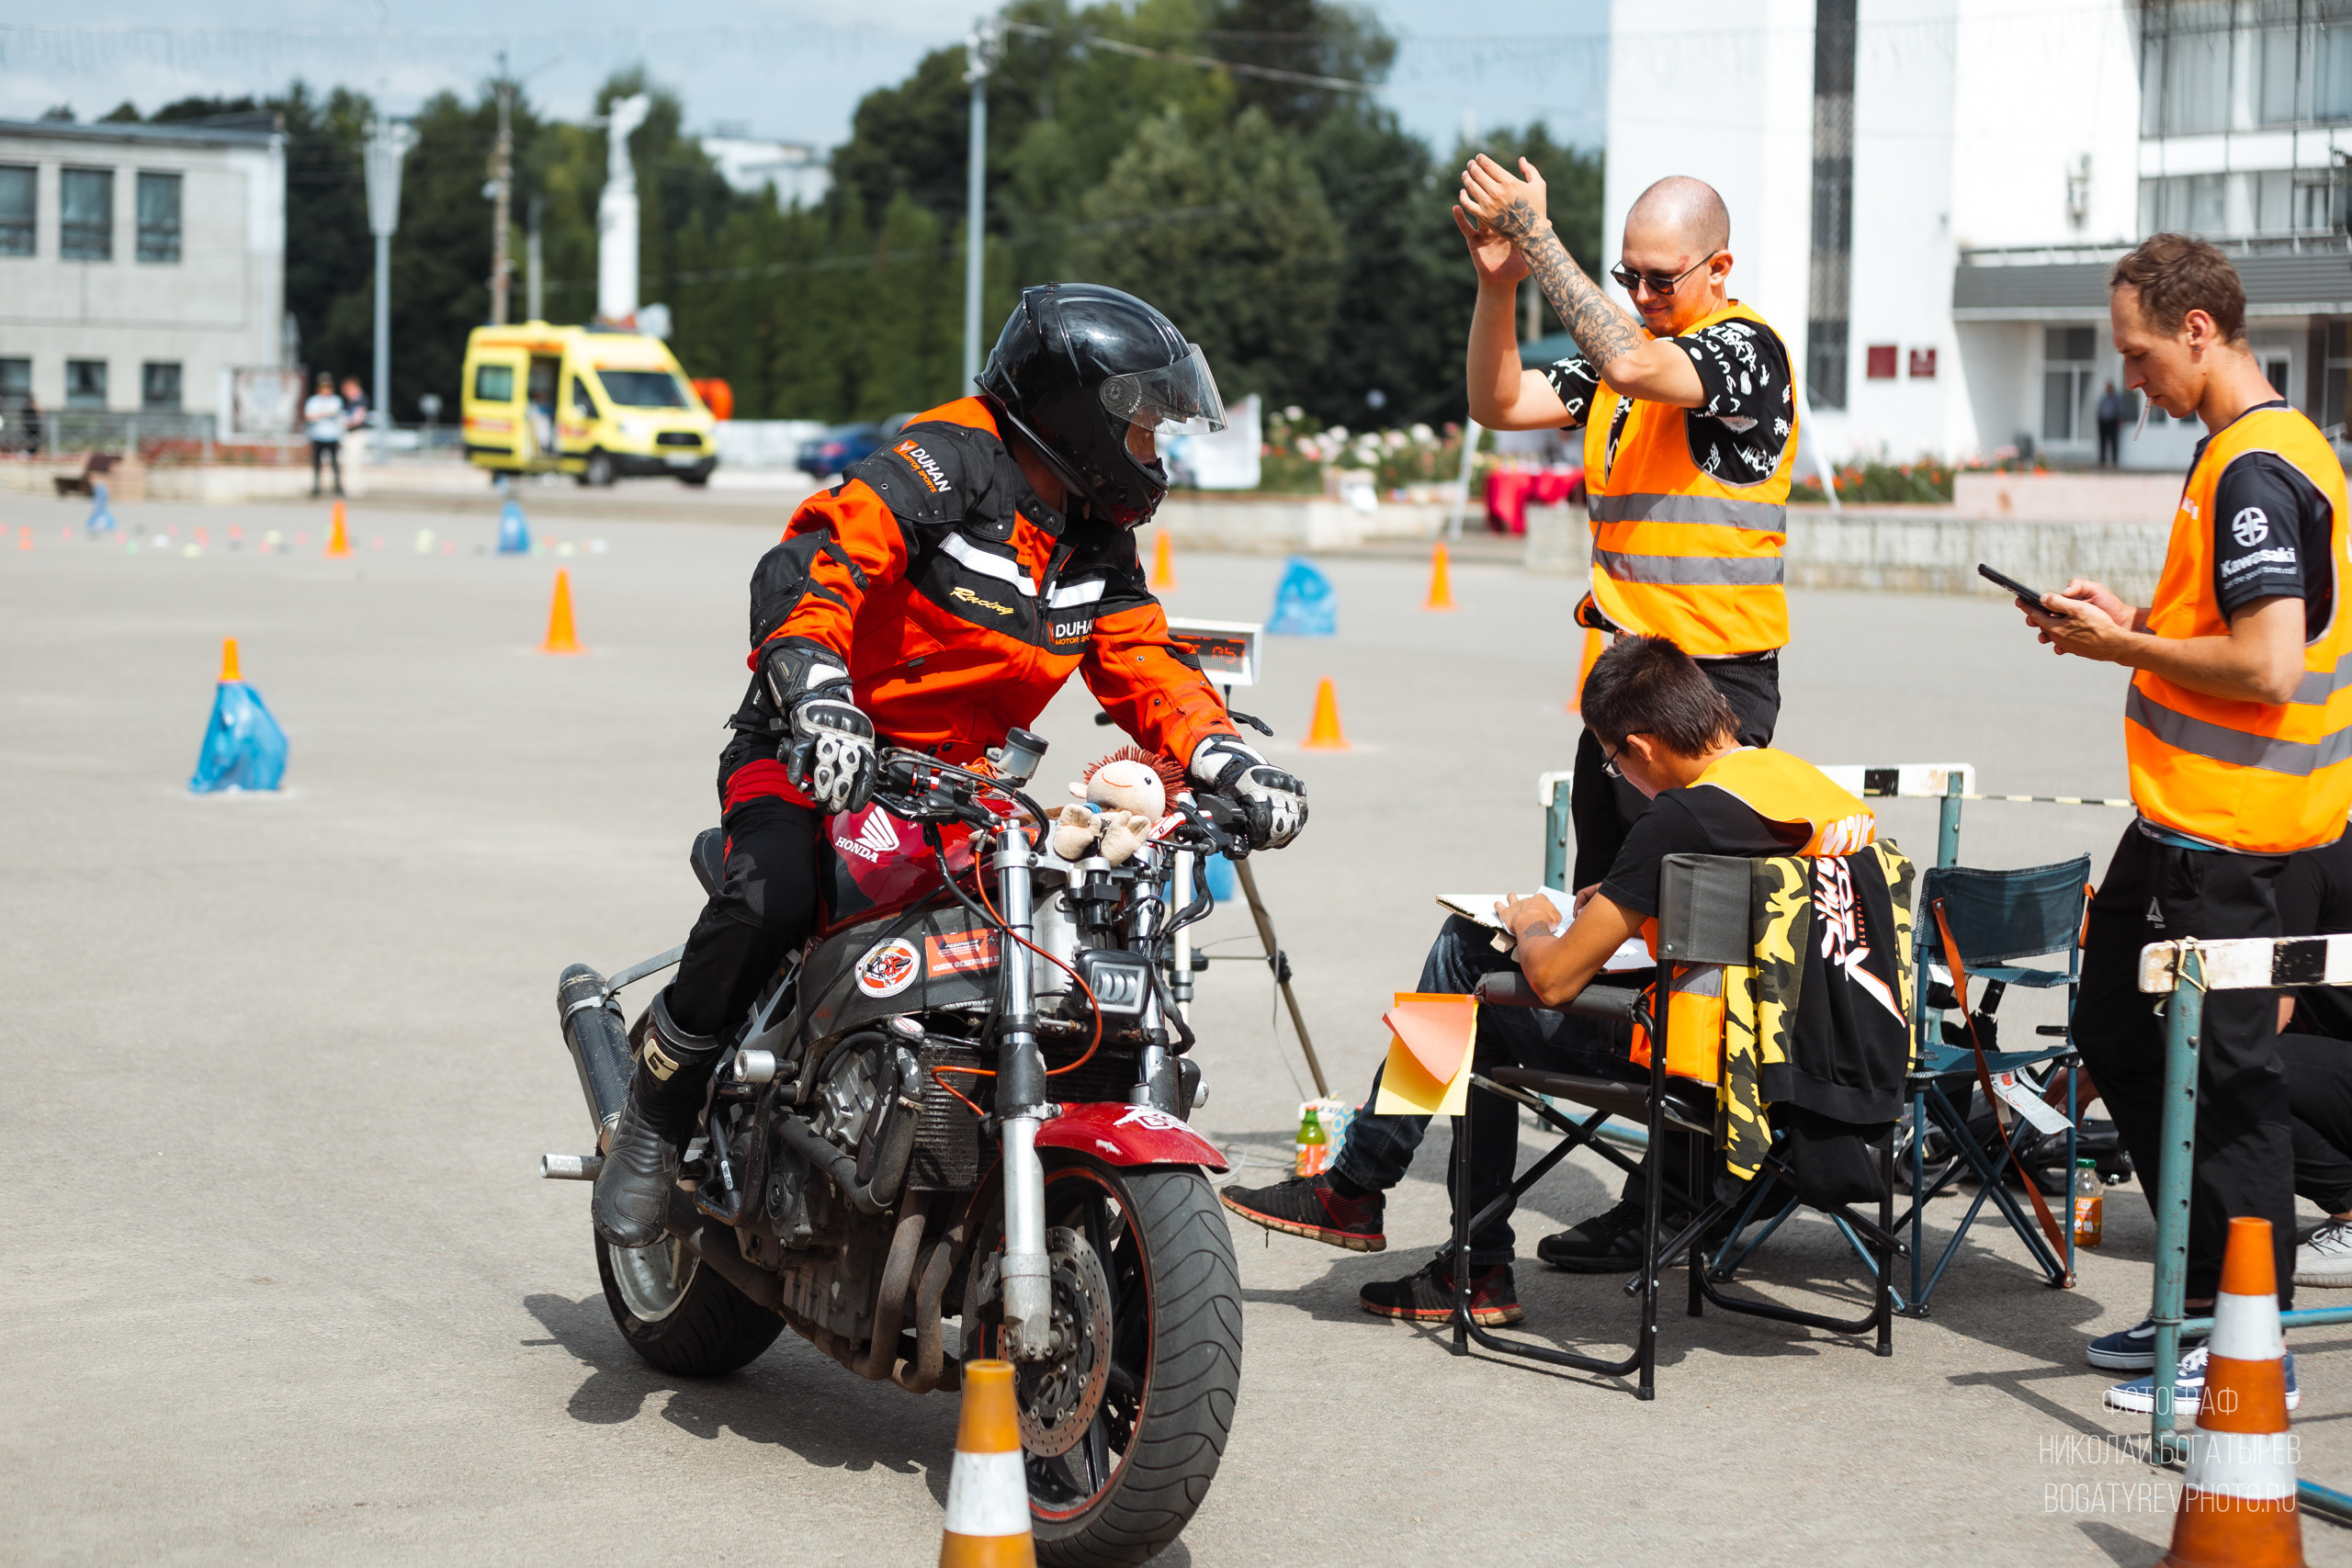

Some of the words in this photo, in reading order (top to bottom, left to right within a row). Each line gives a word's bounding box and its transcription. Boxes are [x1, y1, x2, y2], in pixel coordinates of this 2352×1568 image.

[910, 447, 952, 492] DUHAN
[918, 469, 938, 493] SPORTS
[2220, 547, 2296, 578] Kawasaki
[950, 586, 1014, 615] Racing
[1056, 616, 1095, 637] DUHA
[1056, 636, 1080, 646] MOTOR
[835, 837, 879, 863] HONDA
[932, 962, 954, 972] КУБОК
[954, 957, 993, 968] ФЕДЕРАЦИИ
